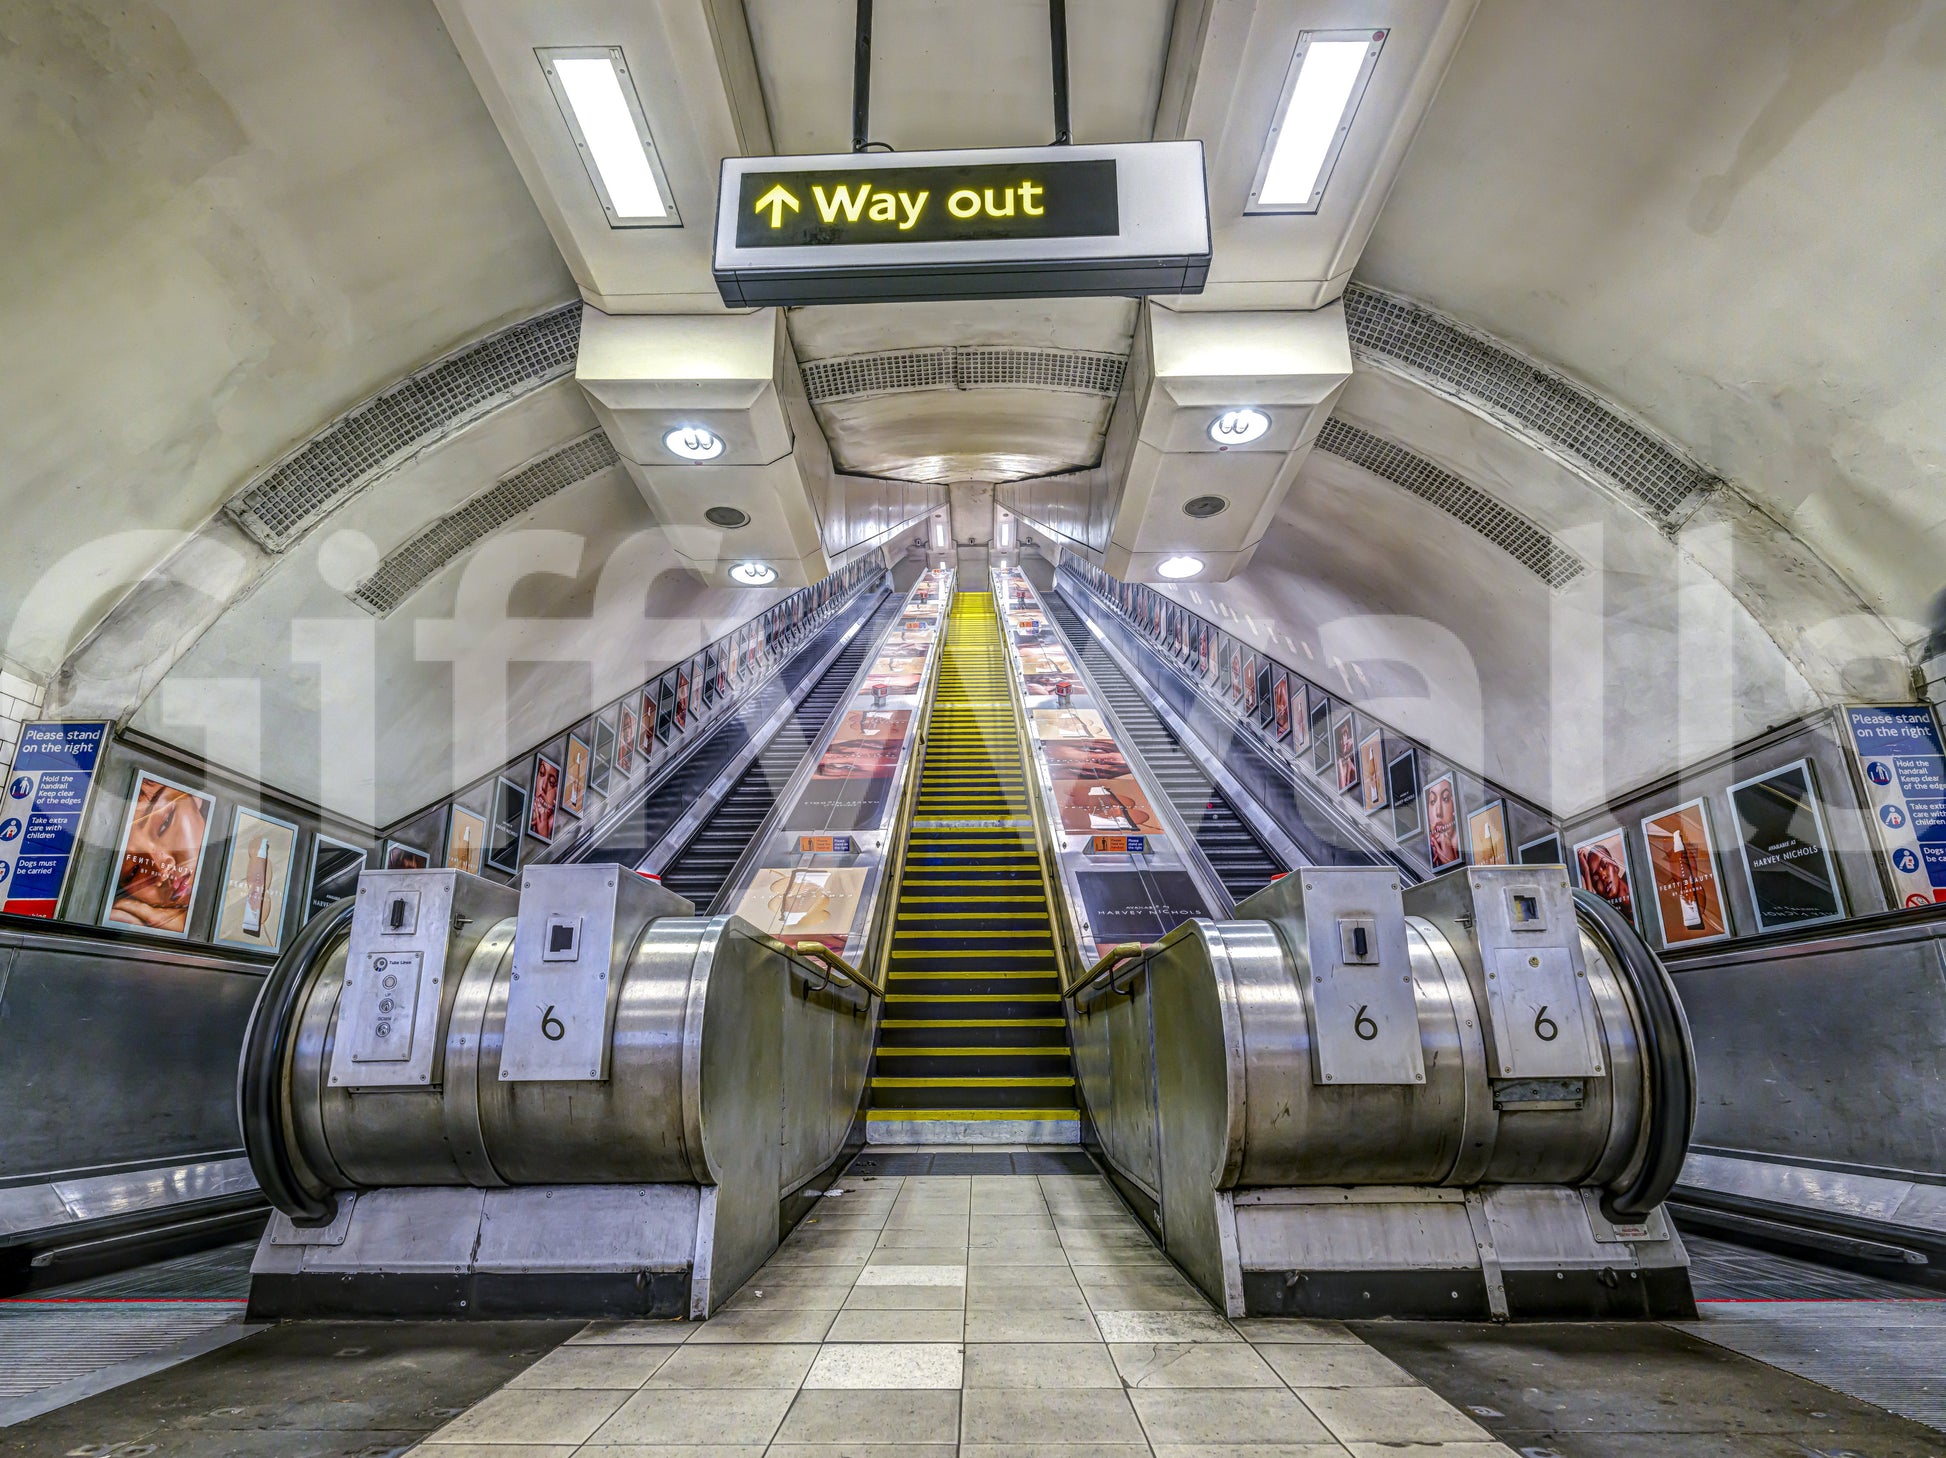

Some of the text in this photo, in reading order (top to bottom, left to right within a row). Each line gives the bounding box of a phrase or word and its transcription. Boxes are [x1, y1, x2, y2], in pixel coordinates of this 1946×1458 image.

[811, 180, 1044, 230] Way out
[1852, 713, 1930, 724] Please stand
[26, 730, 100, 740] Please stand
[1857, 726, 1932, 738] on the right
[22, 742, 94, 754] on the right
[1753, 845, 1818, 867] HARVEY NICHOLS
[1924, 848, 1944, 856] Dogs
[126, 854, 193, 874] FENTY BEAUTY
[541, 1005, 565, 1041] 6
[1354, 1005, 1378, 1040] 6
[1534, 1005, 1558, 1041] 6
